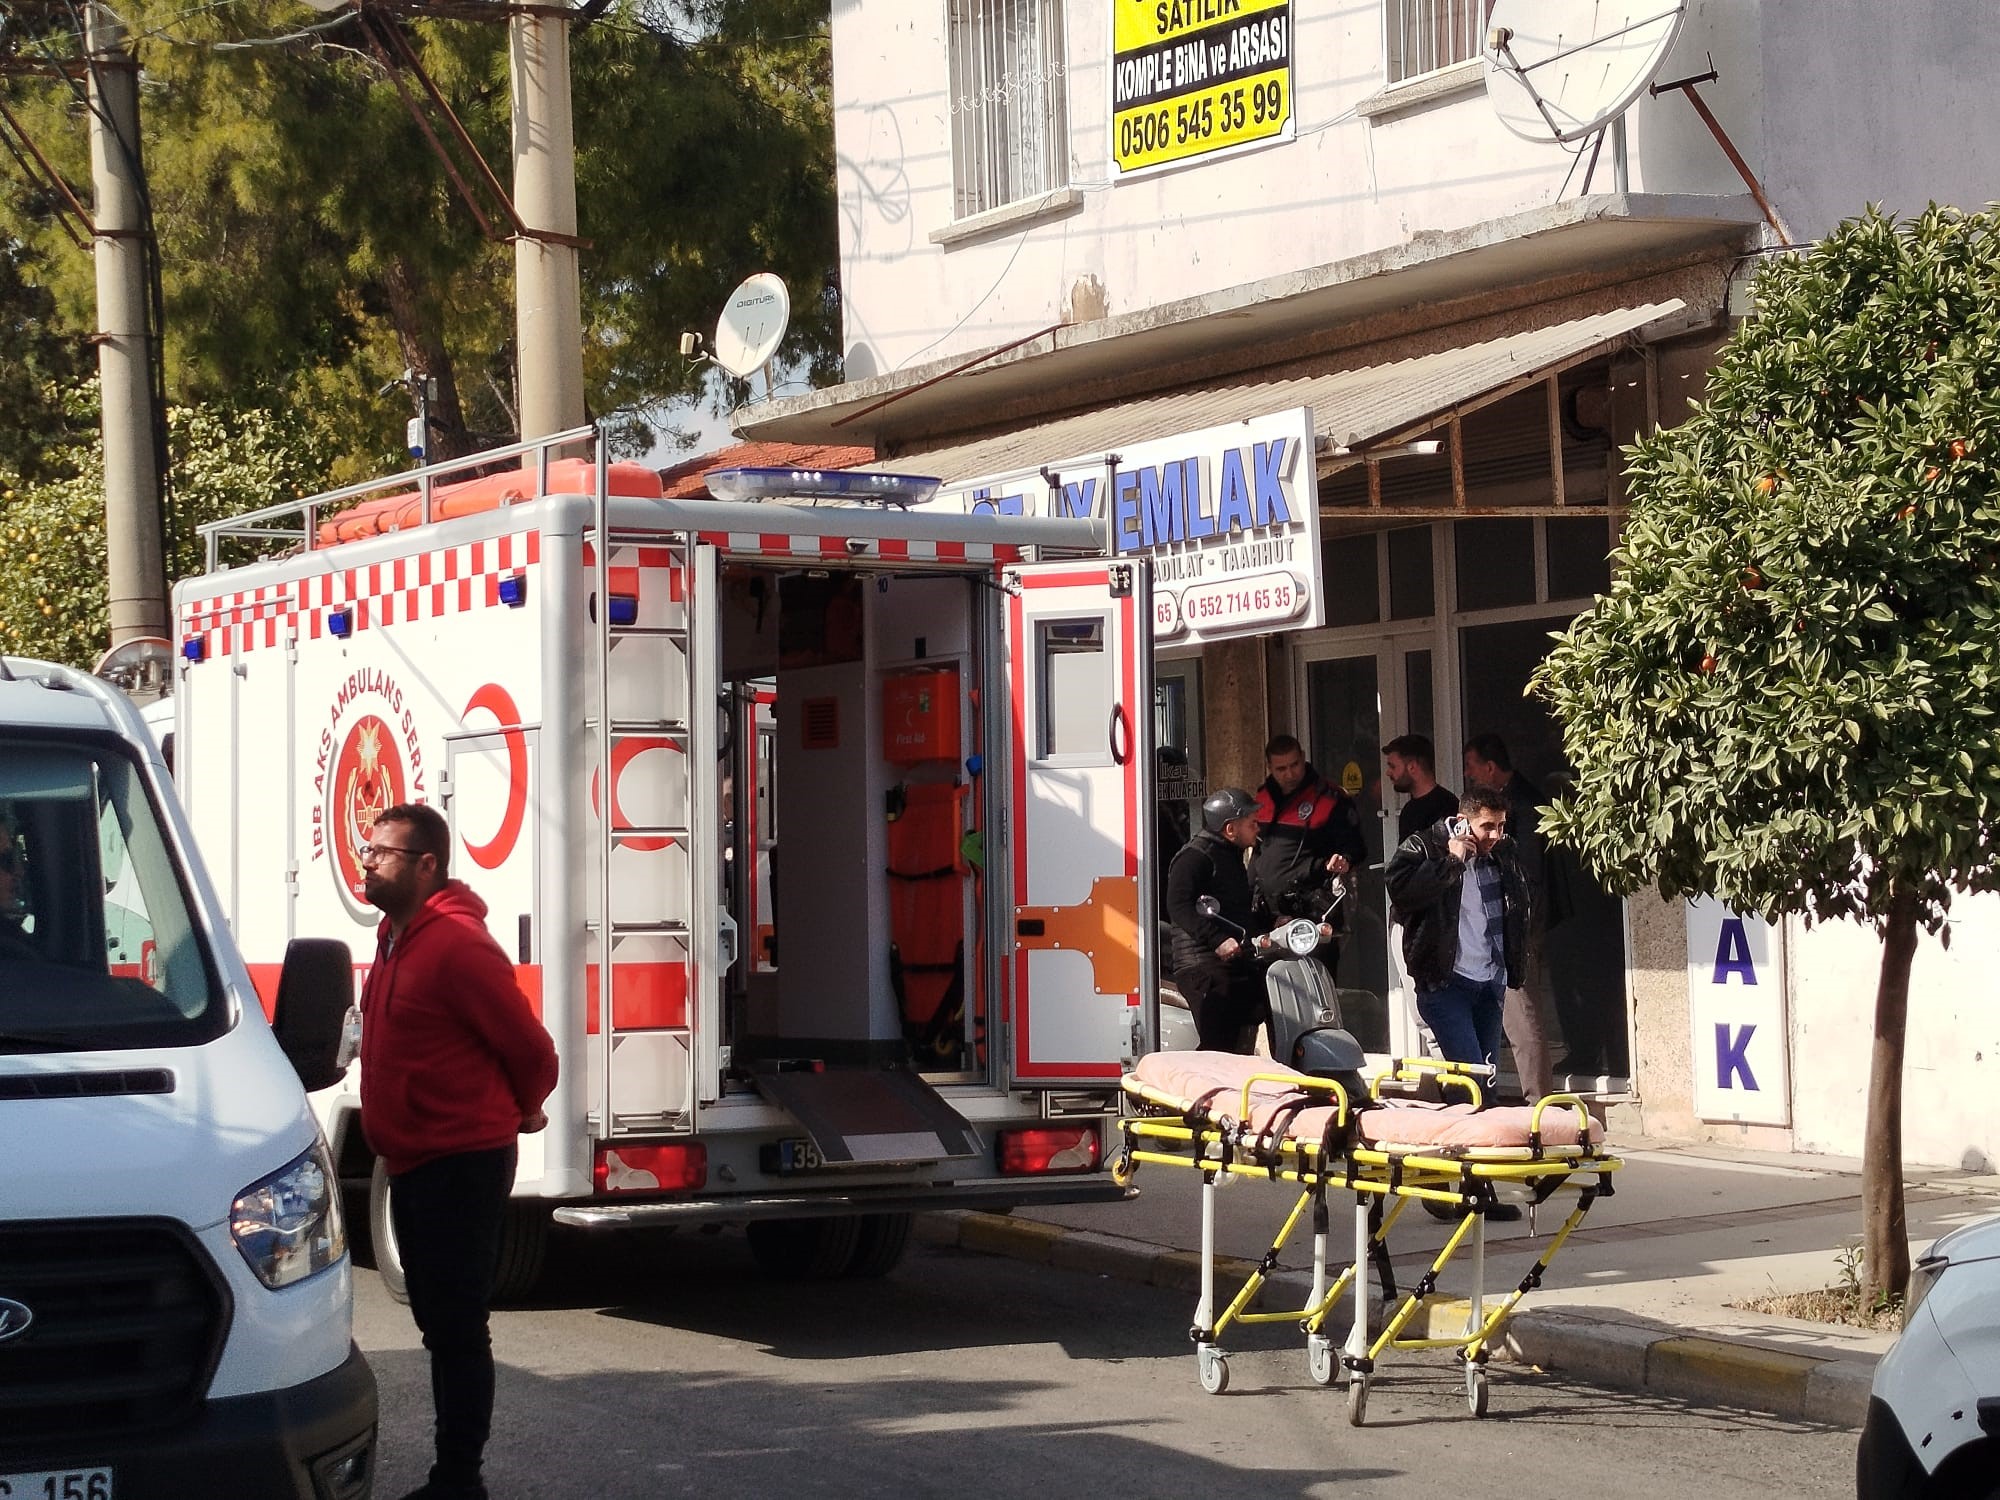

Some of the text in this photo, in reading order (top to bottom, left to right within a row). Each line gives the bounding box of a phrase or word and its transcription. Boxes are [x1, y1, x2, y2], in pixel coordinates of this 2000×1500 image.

[1116, 50, 1172, 102] KOMPLE
[1210, 44, 1226, 76] ve
[1229, 16, 1286, 71] ARSASI
[1121, 79, 1281, 157] 0506 545 35 99
[1117, 438, 1292, 552] EMLAK
[1153, 552, 1203, 584] ADİLAT
[1219, 533, 1295, 572] TAAHHÜT
[878, 577, 889, 593] 10
[1188, 586, 1290, 618] 0 552 714 65 35
[1157, 603, 1171, 623] 65
[314, 728, 332, 794] AKS
[331, 667, 403, 728] AMBULANS
[402, 709, 429, 806] SERVİ
[1712, 918, 1760, 1091] AK
[793, 1144, 818, 1168] 35
[43, 1473, 108, 1500] 156
